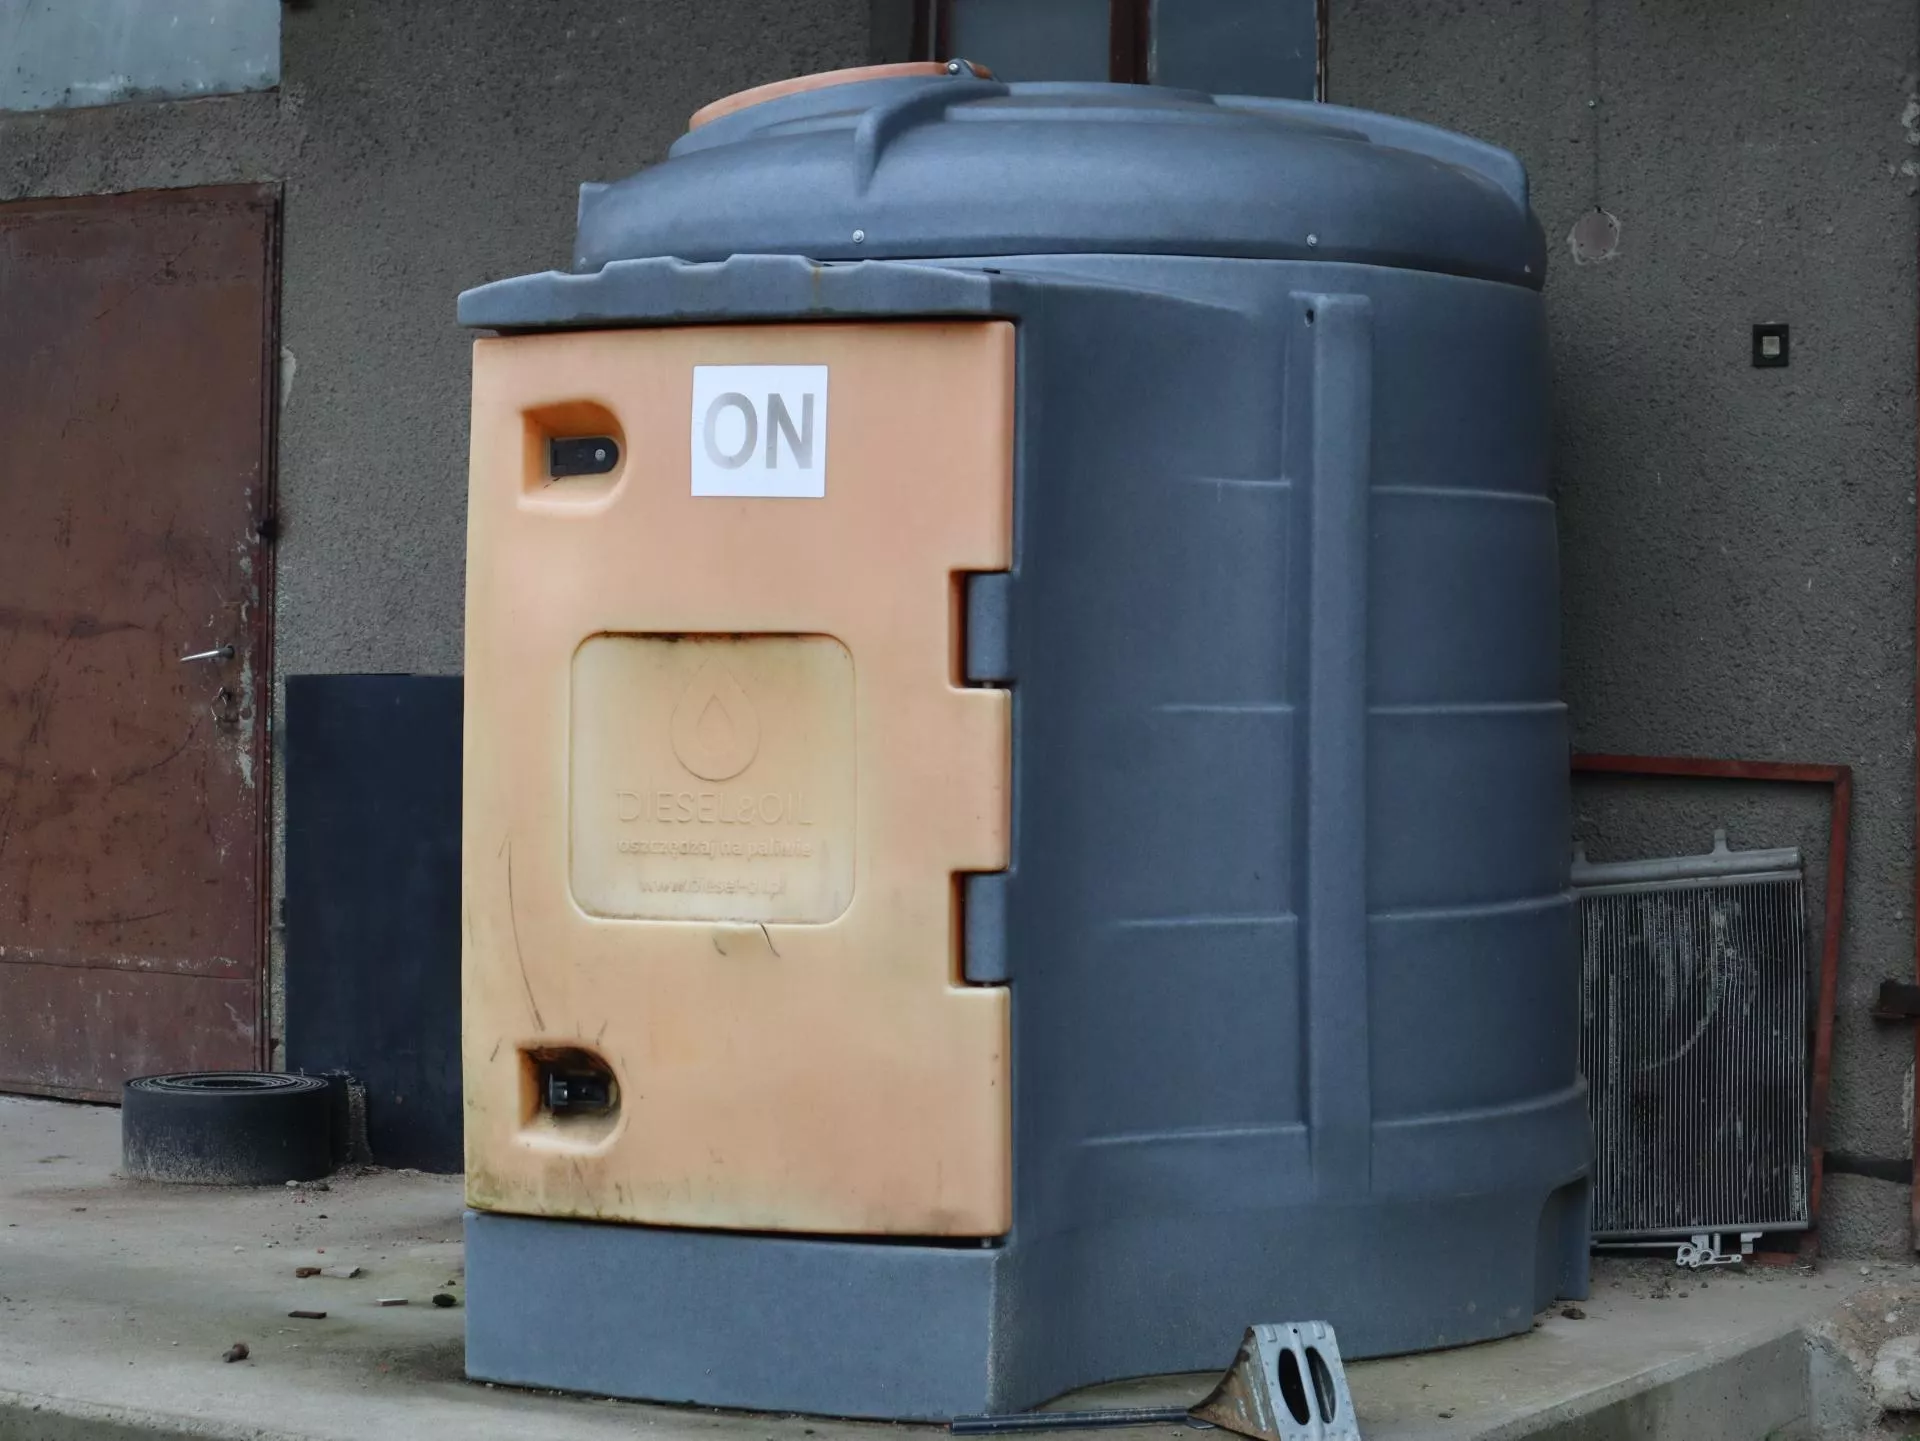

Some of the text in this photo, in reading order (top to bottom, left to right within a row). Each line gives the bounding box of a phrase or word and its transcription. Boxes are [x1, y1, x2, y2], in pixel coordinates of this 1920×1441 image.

[703, 391, 814, 470] ON
[617, 790, 813, 825] DIESEL&OIL
[720, 840, 743, 856] na
[747, 837, 813, 862] paliwie
